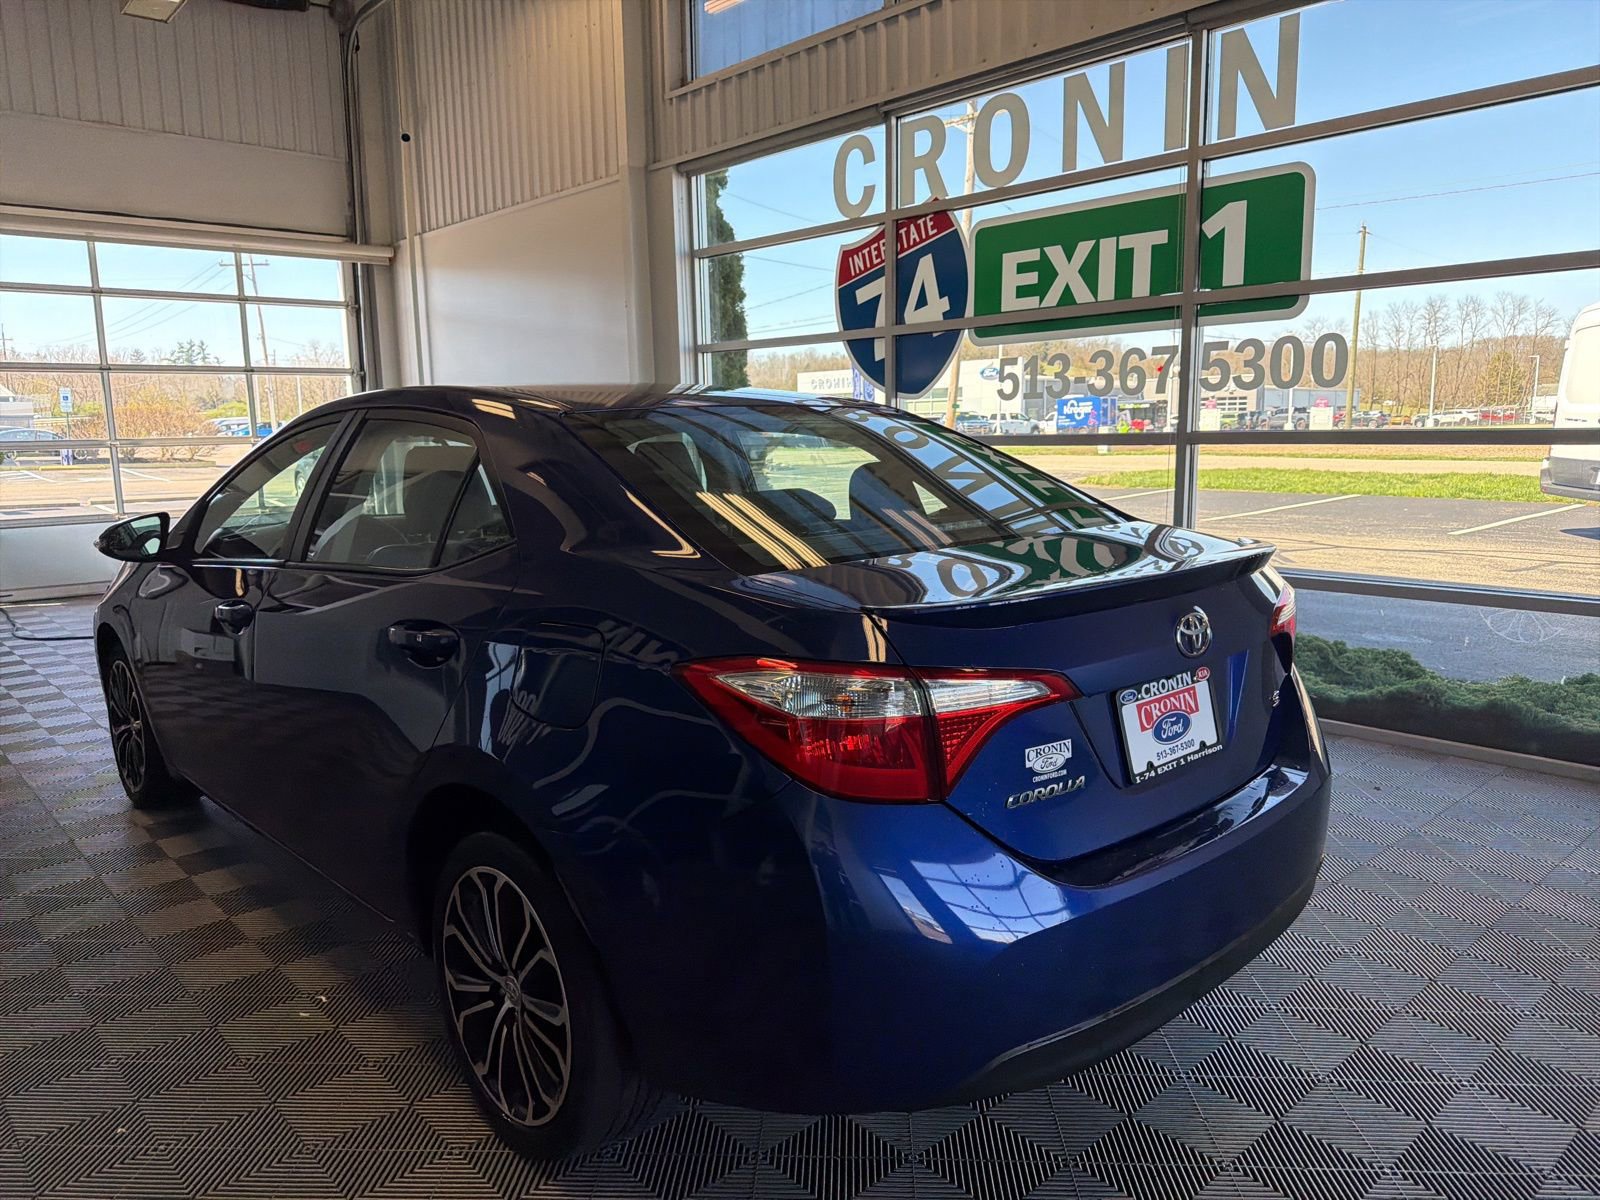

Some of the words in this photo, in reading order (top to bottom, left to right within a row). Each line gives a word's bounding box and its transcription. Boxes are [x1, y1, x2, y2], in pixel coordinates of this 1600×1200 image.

[833, 13, 1301, 219] CRONIN
[849, 215, 937, 276] INTETATE
[1001, 229, 1169, 312] EXIT
[1202, 200, 1247, 287] 1
[855, 253, 950, 361] 74
[1064, 401, 1093, 419] Kroger
[1141, 671, 1192, 698] CRONIN
[1198, 669, 1208, 678] KIA
[1141, 690, 1196, 728] CRONIN
[1161, 717, 1184, 739] Ford
[1027, 741, 1070, 762] CRONIN
[1040, 757, 1059, 770] Ford
[1135, 770, 1155, 784] I-74
[1157, 760, 1178, 774] EXIT
[1180, 757, 1186, 767] 1
[1187, 744, 1223, 763] Harrison
[1156, 739, 1195, 761] 513-367-5300
[1006, 775, 1085, 809] COROLLA
